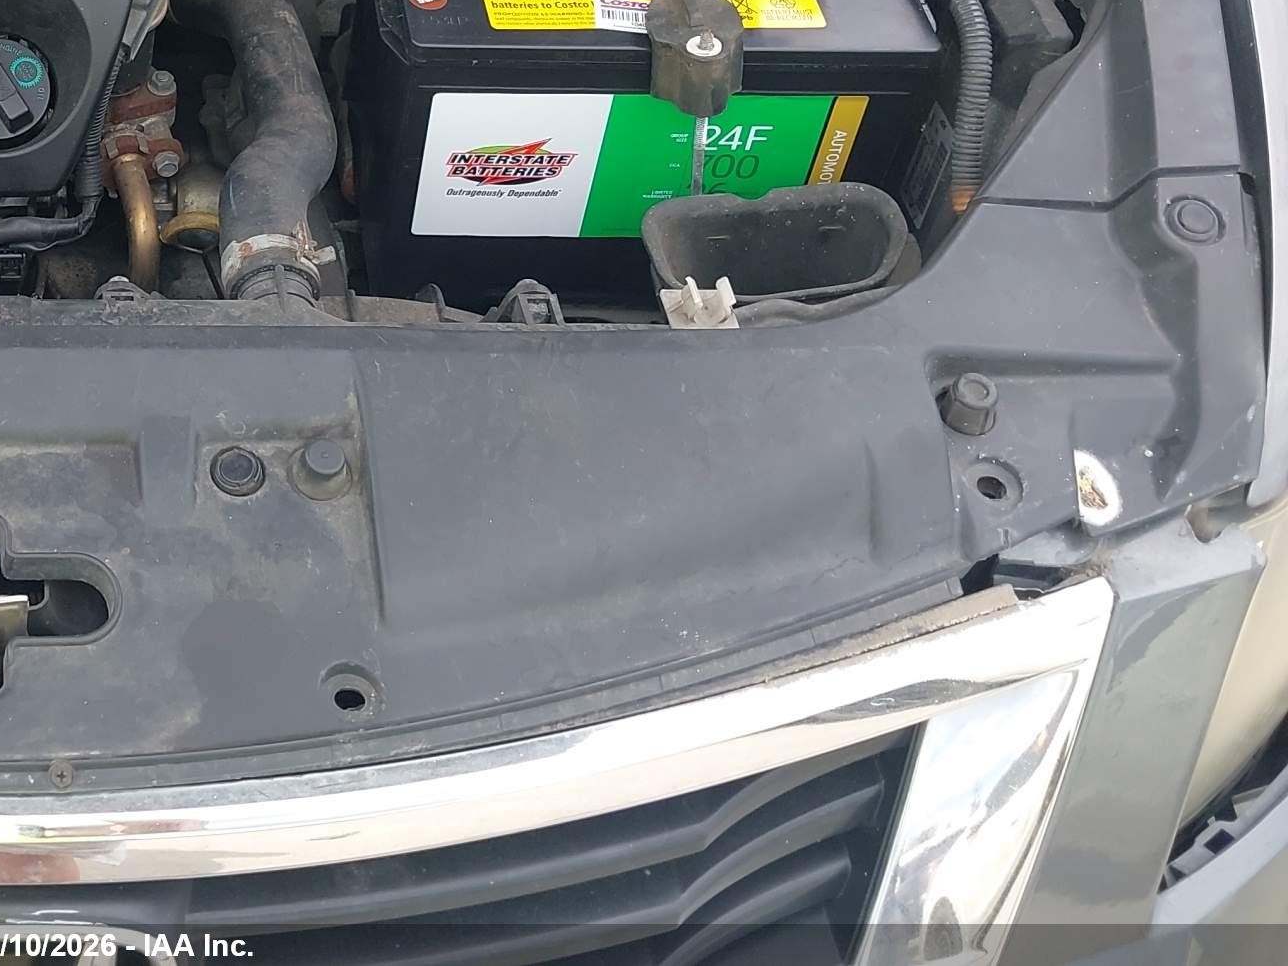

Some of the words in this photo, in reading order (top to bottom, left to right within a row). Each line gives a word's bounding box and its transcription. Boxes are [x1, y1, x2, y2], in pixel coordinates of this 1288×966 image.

[491, 0, 539, 9] batteries
[541, 1, 552, 9] to
[554, 1, 590, 9] Costco
[704, 125, 774, 151] 24F
[450, 154, 571, 165] INTERSTATE
[452, 166, 559, 176] BATTERIES
[446, 188, 505, 198] Outrageously
